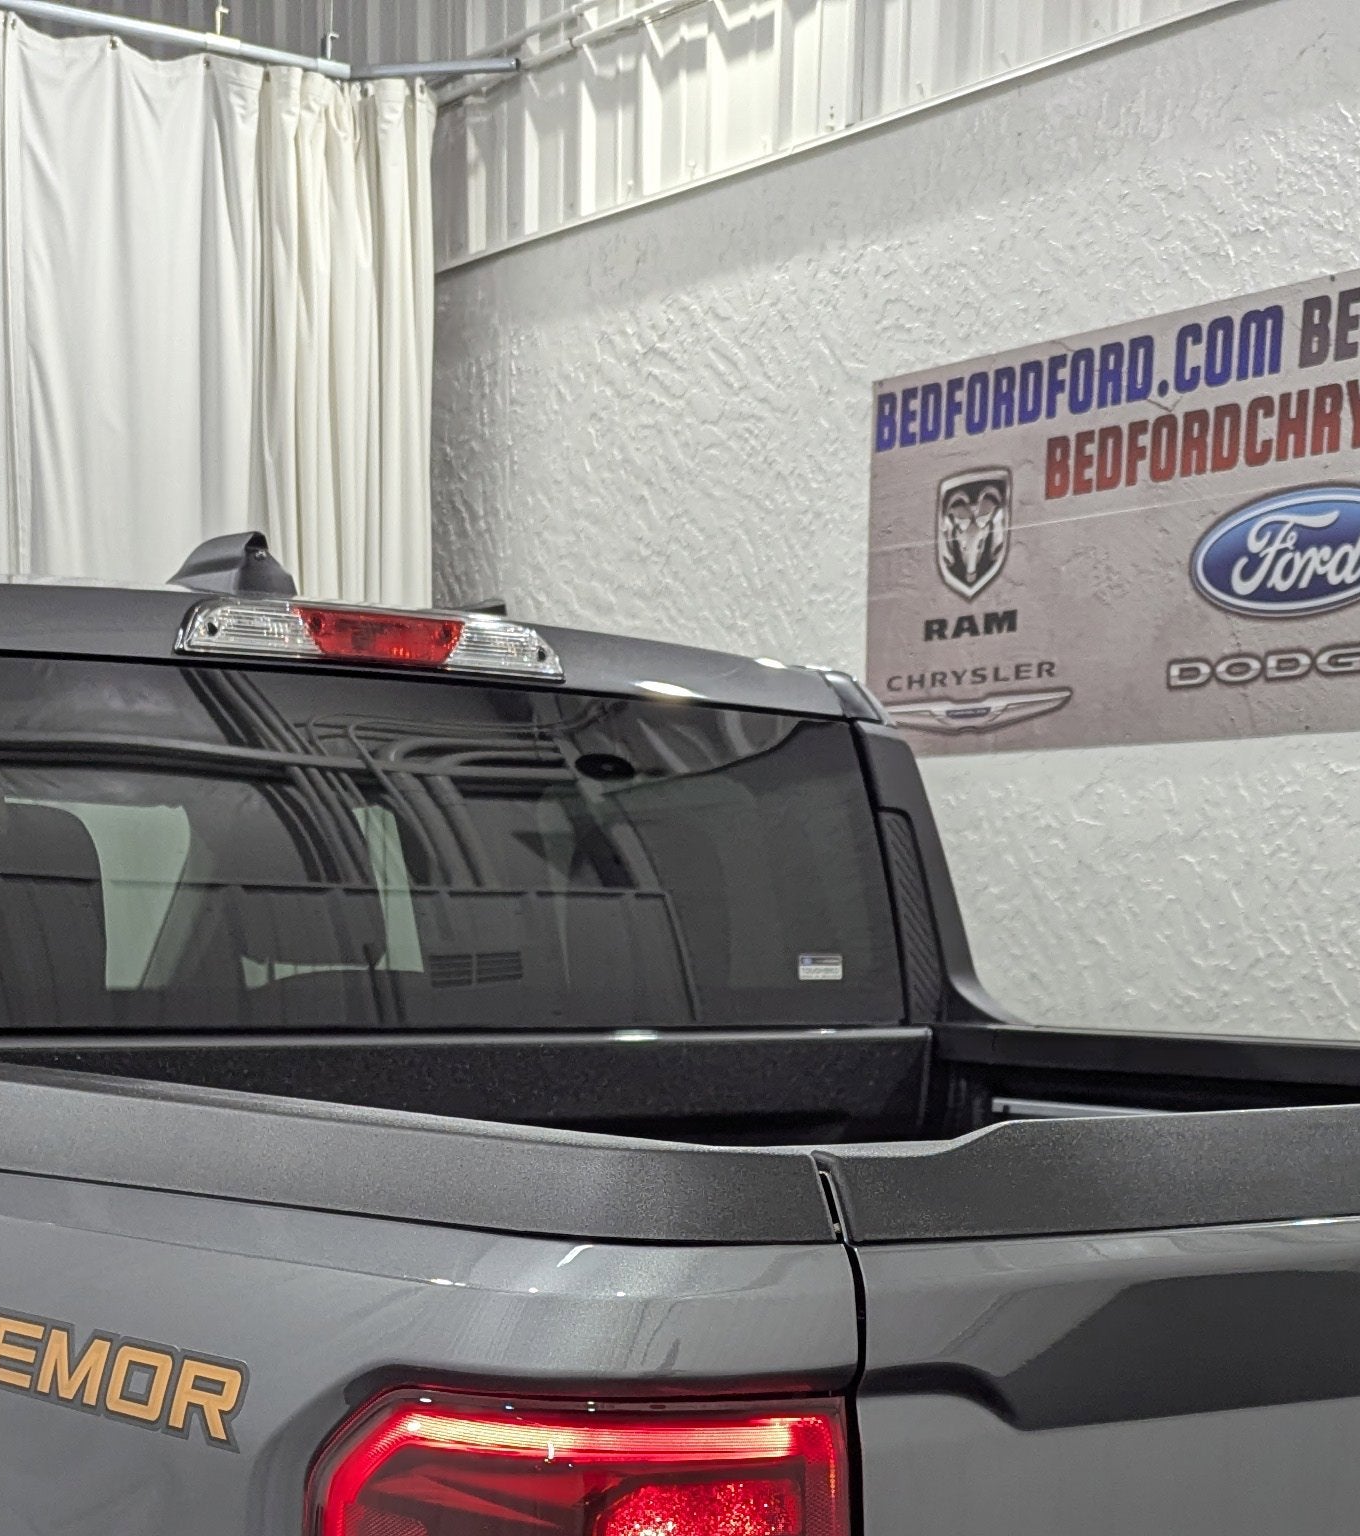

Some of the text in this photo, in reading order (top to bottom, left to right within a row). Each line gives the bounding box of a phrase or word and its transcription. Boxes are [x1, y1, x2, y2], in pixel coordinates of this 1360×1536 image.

[874, 304, 1283, 454] BEDFORDFORD.COM
[923, 609, 1018, 642] RAM
[886, 661, 1056, 692] CHRYSLER
